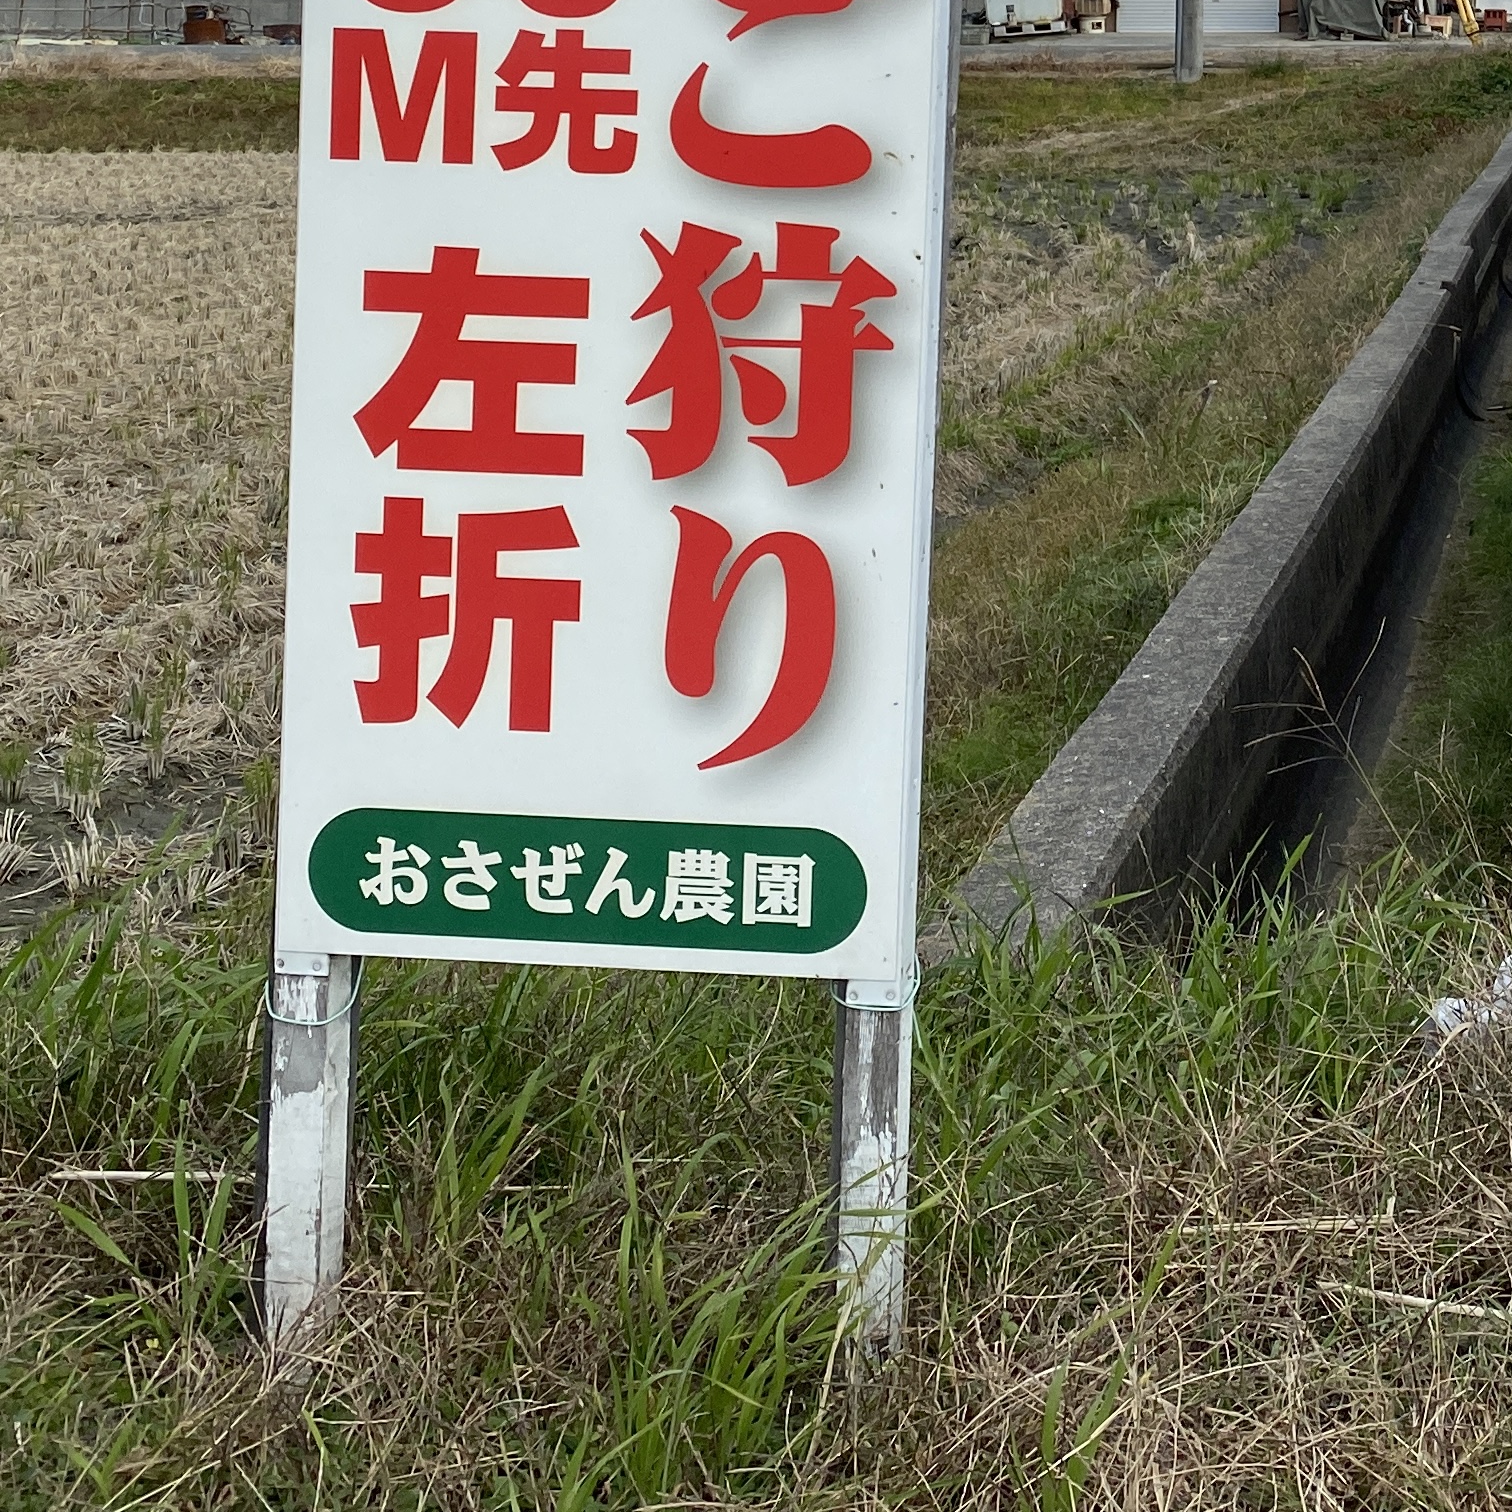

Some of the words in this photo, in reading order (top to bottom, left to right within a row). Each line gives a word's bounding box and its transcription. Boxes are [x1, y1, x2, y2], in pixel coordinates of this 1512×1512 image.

[350, 245, 590, 733] 左折
[359, 835, 817, 928] おさぜん農園
